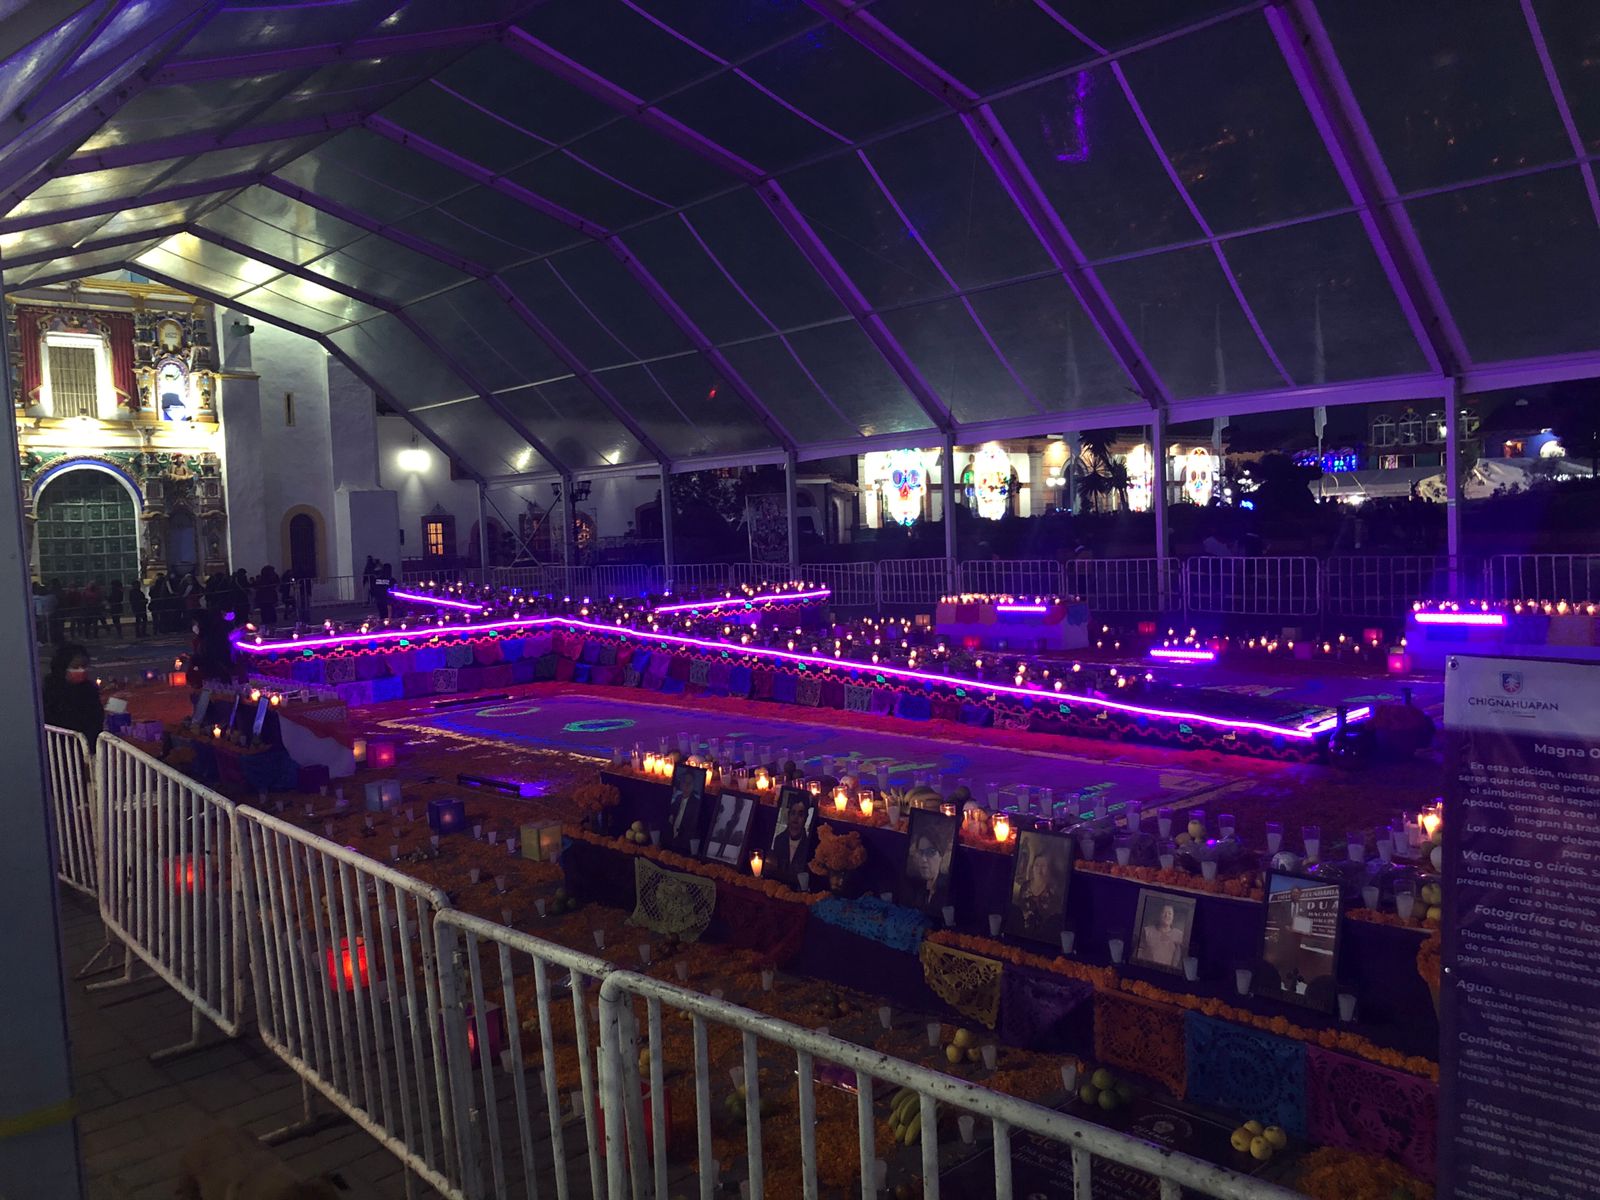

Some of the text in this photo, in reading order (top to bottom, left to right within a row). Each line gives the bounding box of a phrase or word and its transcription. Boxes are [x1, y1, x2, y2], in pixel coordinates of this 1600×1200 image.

[1468, 697, 1559, 711] CHIGNAHUAPAN
[1534, 743, 1585, 758] Magna
[1470, 761, 1600, 782] En esta edición, nuestra
[1458, 774, 1487, 783] seres
[1489, 776, 1537, 788] queridos
[1539, 781, 1561, 791] que
[1470, 786, 1480, 794] el
[1482, 787, 1545, 801] simbolismo
[1547, 794, 1564, 804] del
[1508, 802, 1561, 816] contando
[1563, 808, 1584, 818] con
[1586, 811, 1597, 820] el
[1466, 823, 1487, 833] Los
[1489, 826, 1533, 839] objetos
[1536, 831, 1559, 842] que
[1514, 815, 1560, 829] integran
[1563, 821, 1575, 830] la
[1462, 849, 1531, 868] Veladoras
[1534, 861, 1544, 869] o
[1546, 860, 1587, 876] cirios.
[1561, 849, 1592, 860] para
[1466, 865, 1488, 875] una
[1456, 876, 1504, 890] presente
[1506, 883, 1520, 892] en
[1523, 885, 1533, 894] el
[1535, 887, 1564, 898] altar.
[1566, 891, 1575, 900] A
[1474, 903, 1555, 926] Fotografías
[1558, 917, 1577, 929] de
[1508, 896, 1597, 918] cruz o haciendo
[1461, 928, 1495, 942] Flores.
[1498, 935, 1539, 949] Adorno
[1541, 941, 1556, 952] de
[1558, 945, 1585, 958] todo
[1529, 926, 1543, 937] de
[1545, 930, 1562, 941] los
[1464, 942, 1479, 952] de
[1555, 958, 1594, 973] nubes,
[1491, 959, 1499, 968] o
[1500, 961, 1553, 978] cualquier
[1554, 970, 1579, 983] otra
[1456, 979, 1496, 995] Agua.
[1499, 988, 1513, 998] Su
[1514, 992, 1569, 1010] presencia
[1570, 1004, 1585, 1013] es
[1467, 994, 1483, 1005] los
[1484, 1000, 1520, 1013] cuatro
[1458, 1031, 1514, 1053] Comida.
[1516, 1046, 1569, 1064] Cualquier
[1466, 1048, 1494, 1060] debe
[1496, 1053, 1527, 1068] haber
[1529, 1063, 1551, 1073] pan
[1553, 1067, 1568, 1077] de
[1491, 1078, 1505, 1088] de
[1466, 1098, 1510, 1118] Frutas
[1470, 1163, 1510, 1183] Papel
